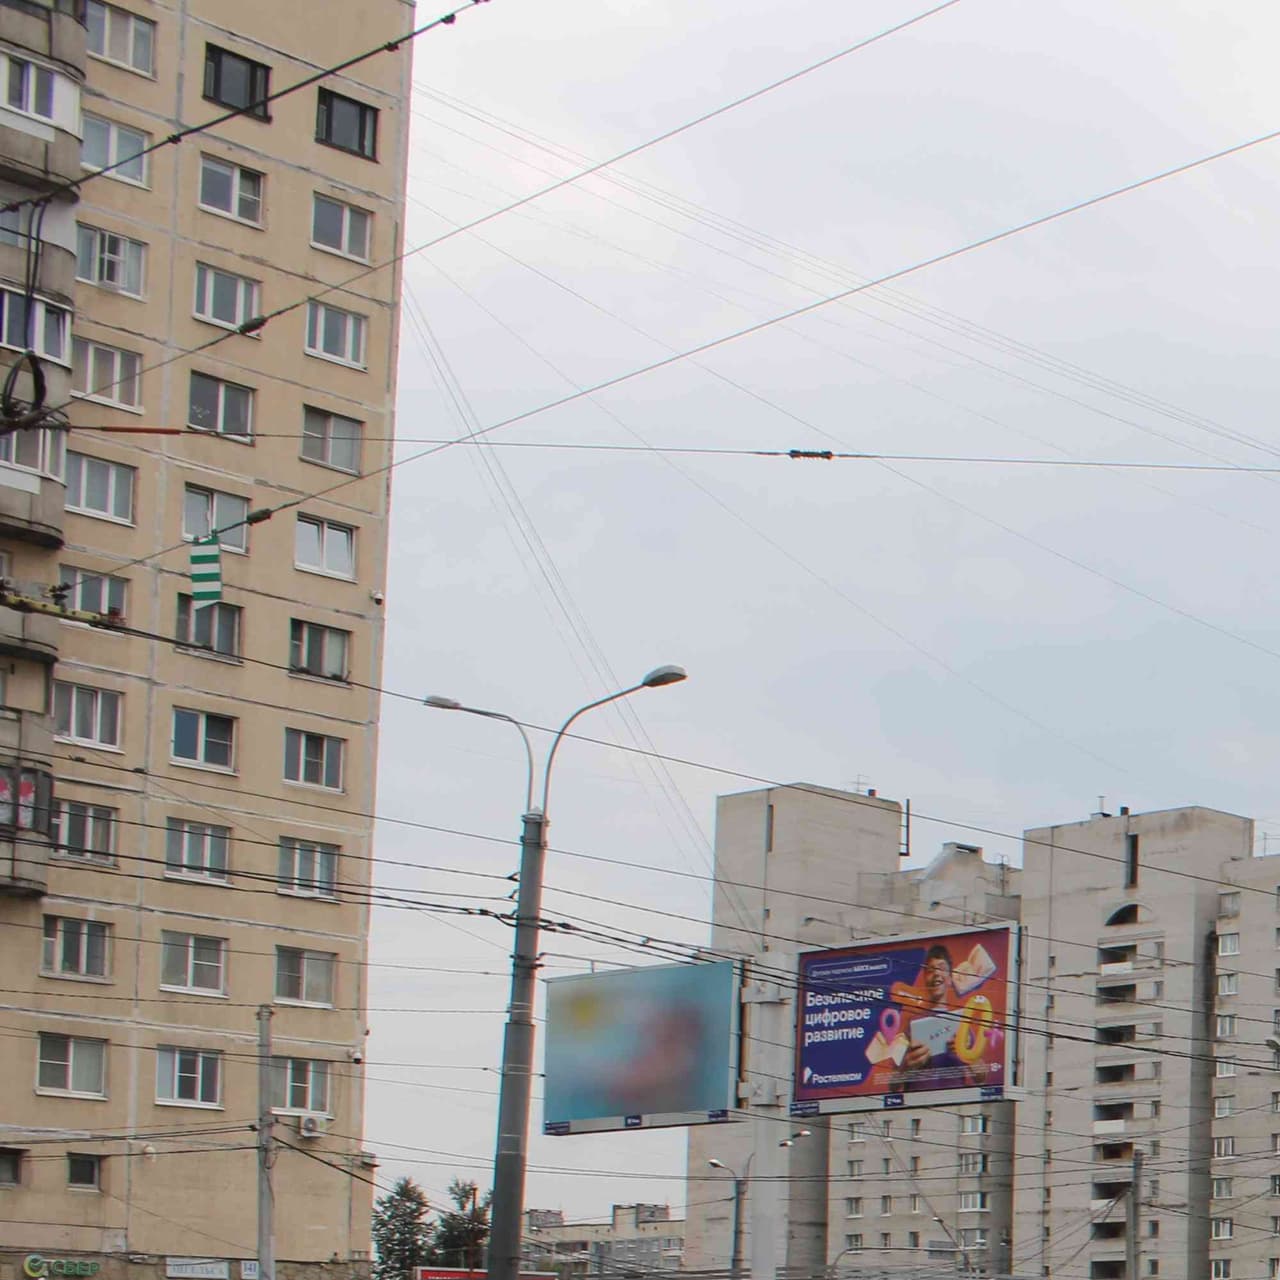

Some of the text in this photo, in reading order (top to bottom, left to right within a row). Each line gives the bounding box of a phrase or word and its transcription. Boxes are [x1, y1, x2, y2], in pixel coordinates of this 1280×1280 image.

[805, 1008, 871, 1028] цифровое
[804, 1027, 864, 1047] развитие
[812, 1071, 863, 1085] Ростелеком
[51, 1259, 100, 1277] СБЕР
